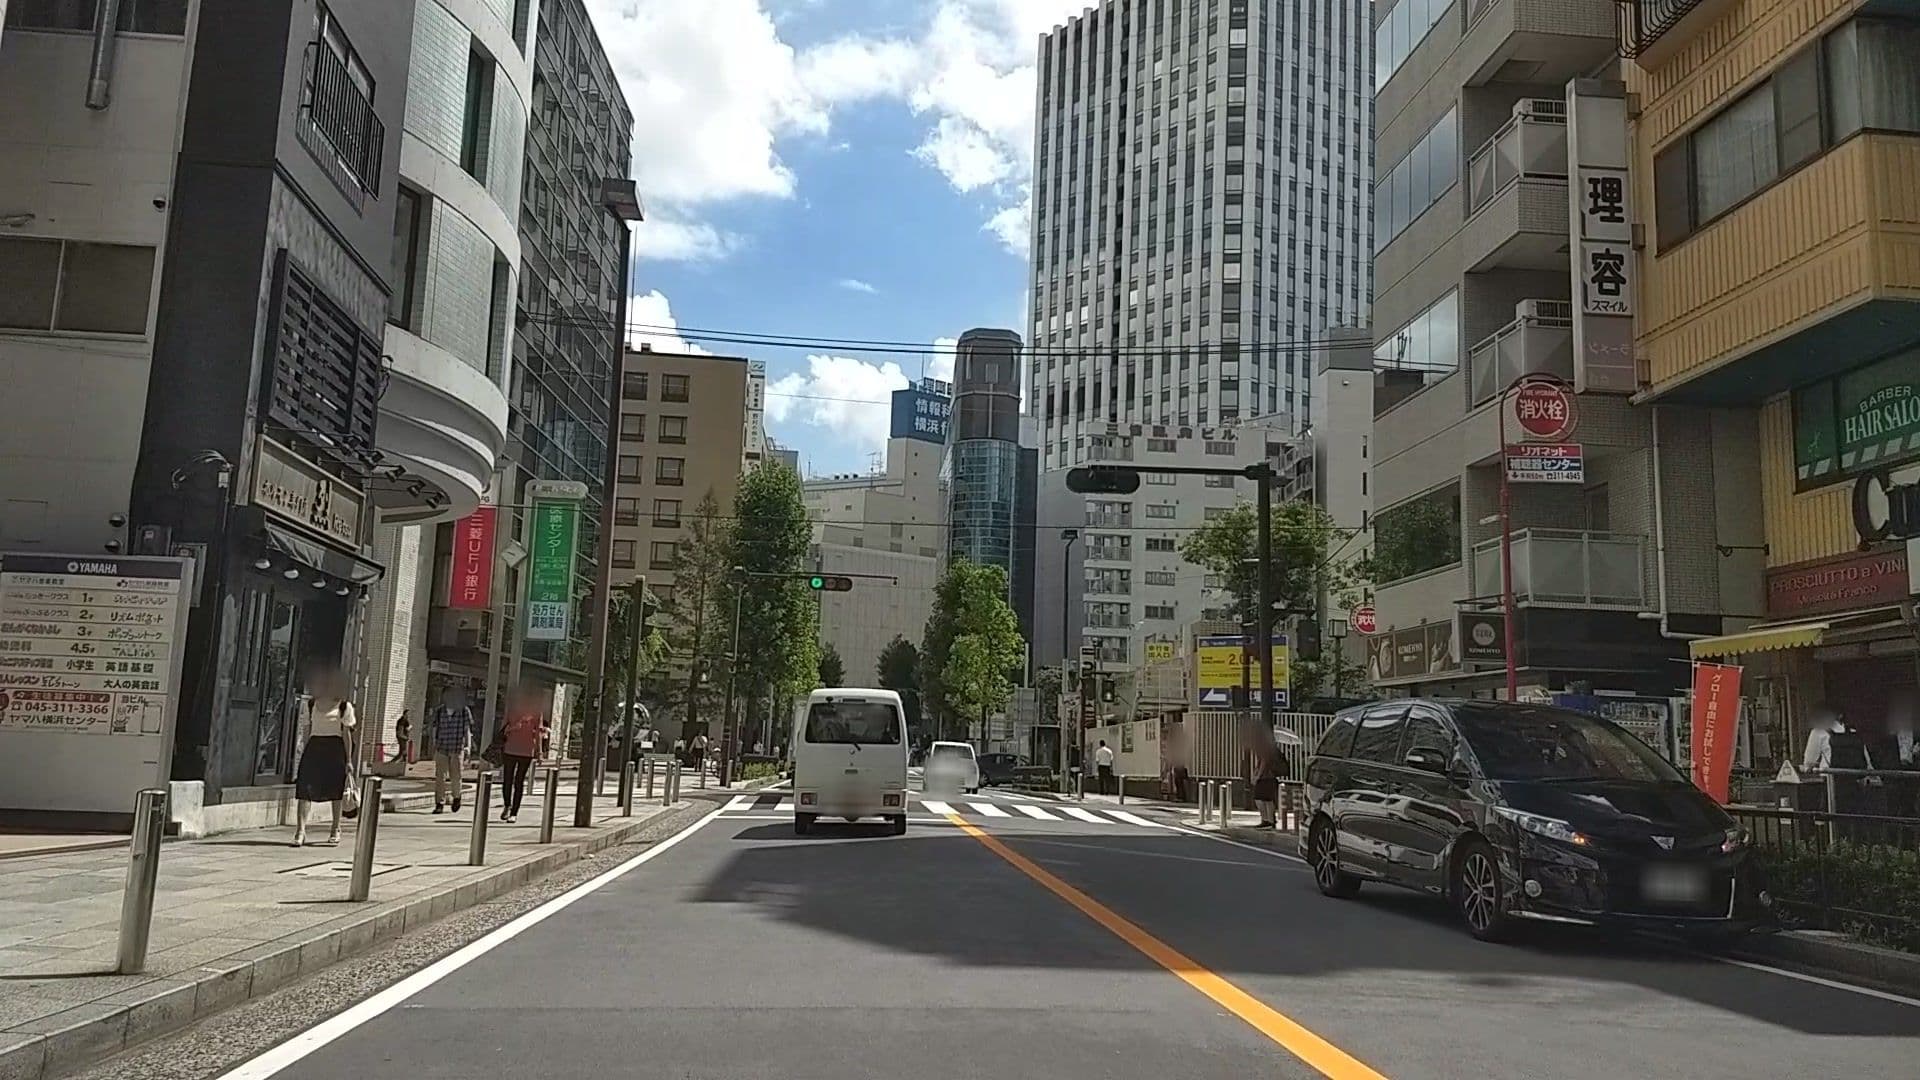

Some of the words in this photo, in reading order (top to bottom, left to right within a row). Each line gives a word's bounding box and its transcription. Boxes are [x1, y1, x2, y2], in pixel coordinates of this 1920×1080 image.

[1588, 177, 1627, 296] 理容
[1592, 300, 1628, 313] スマイル
[1860, 385, 1912, 413] BARBER
[1519, 399, 1564, 420] 消火栓
[1845, 409, 1883, 444] HAIR
[1521, 446, 1567, 456] リオネット
[464, 514, 484, 601] 三菱UFJ銀行
[80, 562, 117, 574] YAMAHA
[532, 604, 564, 617] 処方せん
[66, 660, 95, 671] 小学生
[0, 674, 39, 685] 人レッスン
[103, 680, 160, 690] 大人の英会話
[25, 702, 109, 715] 045-311-3366
[10, 714, 108, 726] ヤマハ横浜センター
